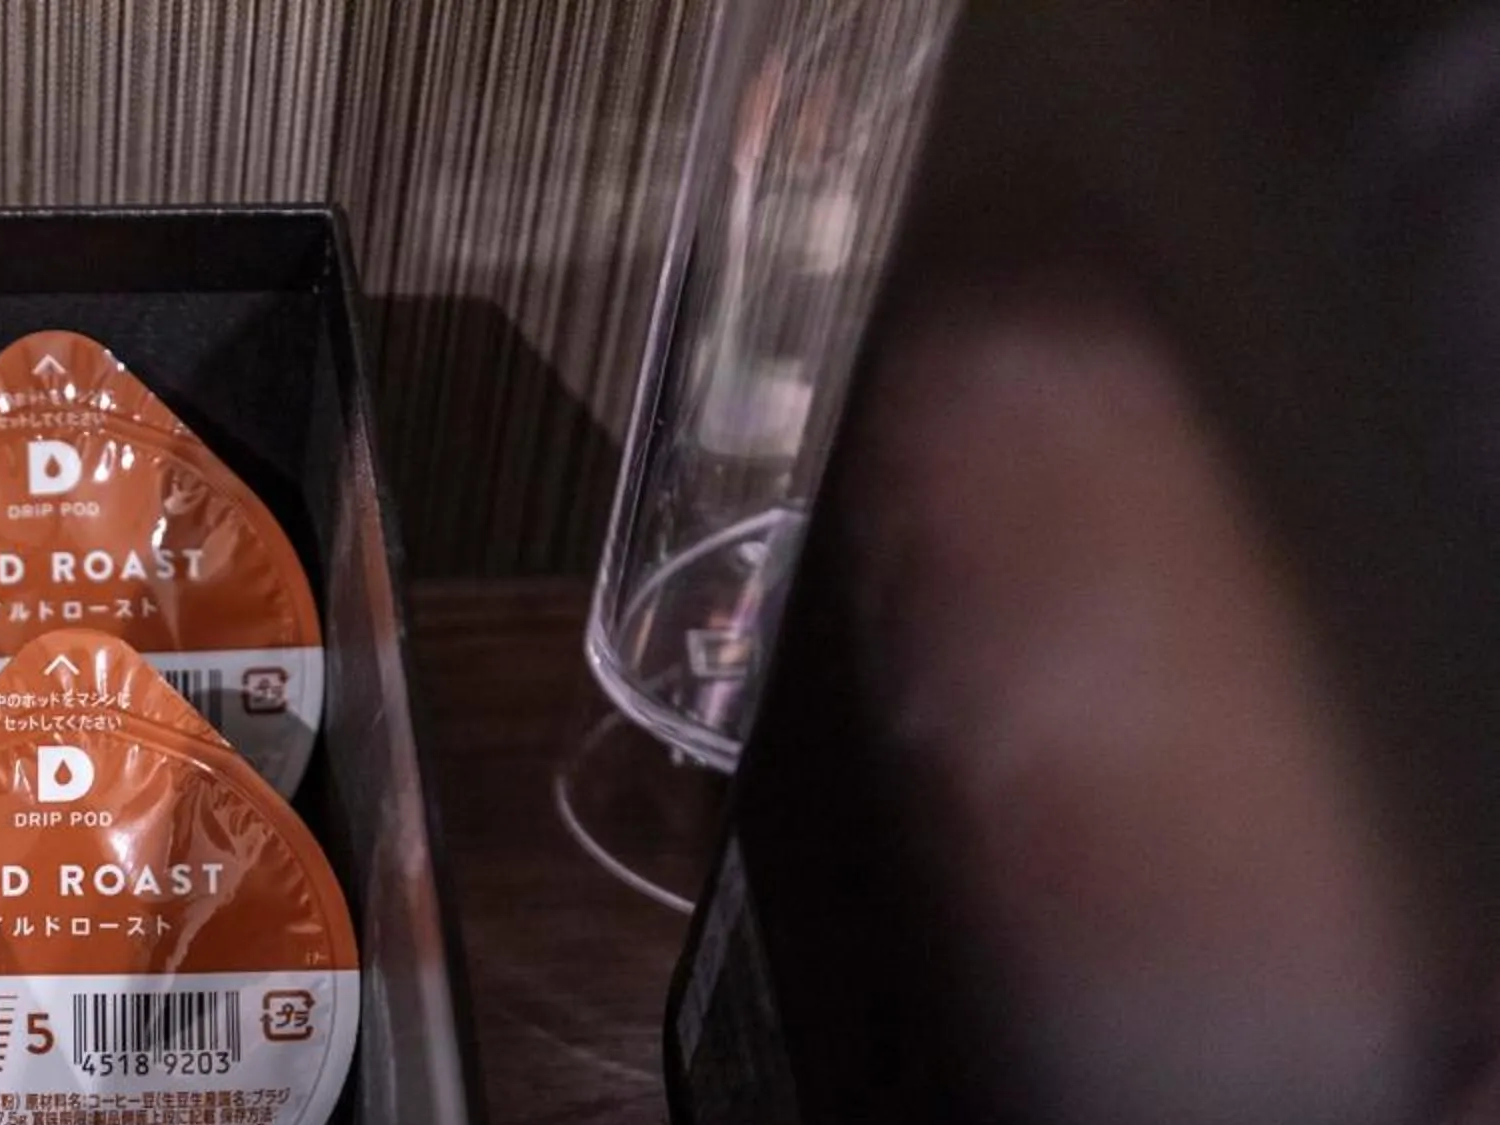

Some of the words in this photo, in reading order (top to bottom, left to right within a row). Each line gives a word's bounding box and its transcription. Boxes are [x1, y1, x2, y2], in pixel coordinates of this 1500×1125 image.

[8, 504, 54, 519] DRIP
[60, 502, 100, 518] POD
[52, 549, 206, 583] ROAST
[4, 715, 122, 731] セットしてください
[15, 813, 62, 827] DRIP
[71, 812, 113, 827] POD
[60, 863, 224, 897] ROAST
[276, 1003, 309, 1028] プラ
[26, 1013, 55, 1055] 5
[82, 1052, 149, 1077] 4518
[163, 1049, 231, 1077] 9203
